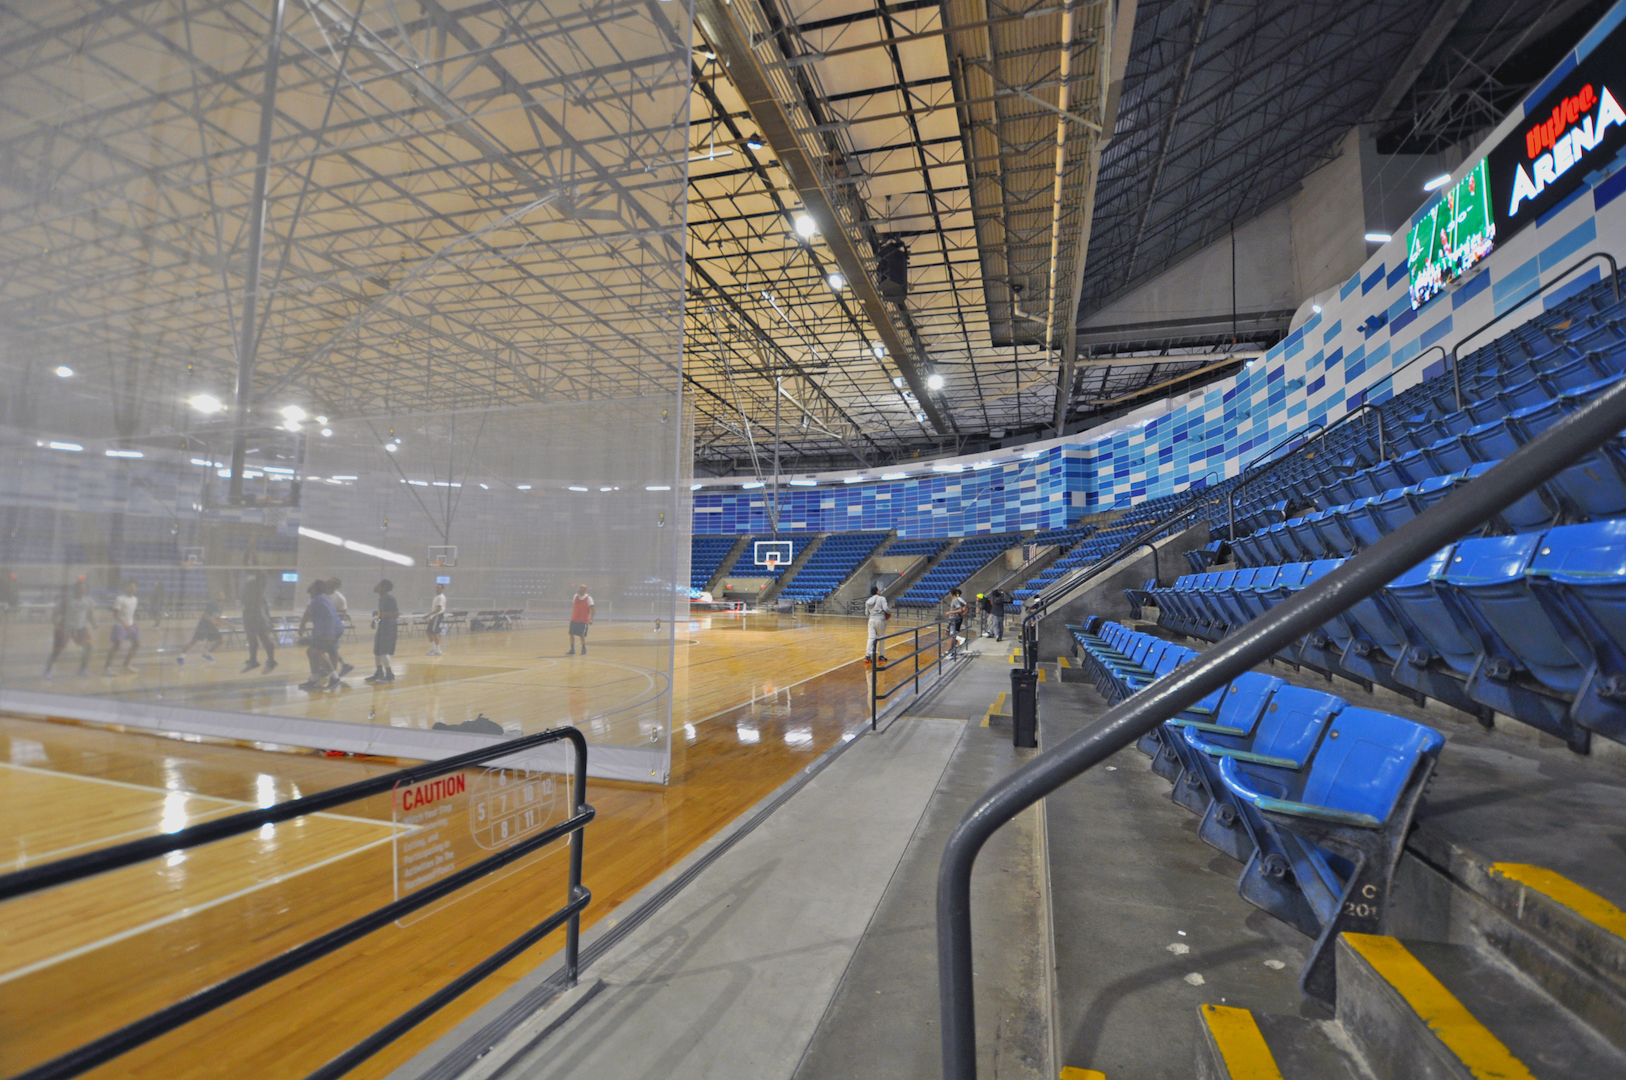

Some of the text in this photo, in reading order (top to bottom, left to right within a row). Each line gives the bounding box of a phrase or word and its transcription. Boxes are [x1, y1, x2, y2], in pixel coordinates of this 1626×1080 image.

[1508, 85, 1626, 217] ARENA
[499, 769, 507, 786] 6
[542, 778, 552, 796] 12
[403, 774, 466, 811] CAUTION
[523, 785, 534, 803] 10
[478, 802, 486, 821] 5
[501, 794, 507, 813] 7
[525, 809, 534, 828] 11
[501, 820, 508, 839] 8
[1362, 884, 1378, 899] C
[1344, 901, 1379, 920] 201
